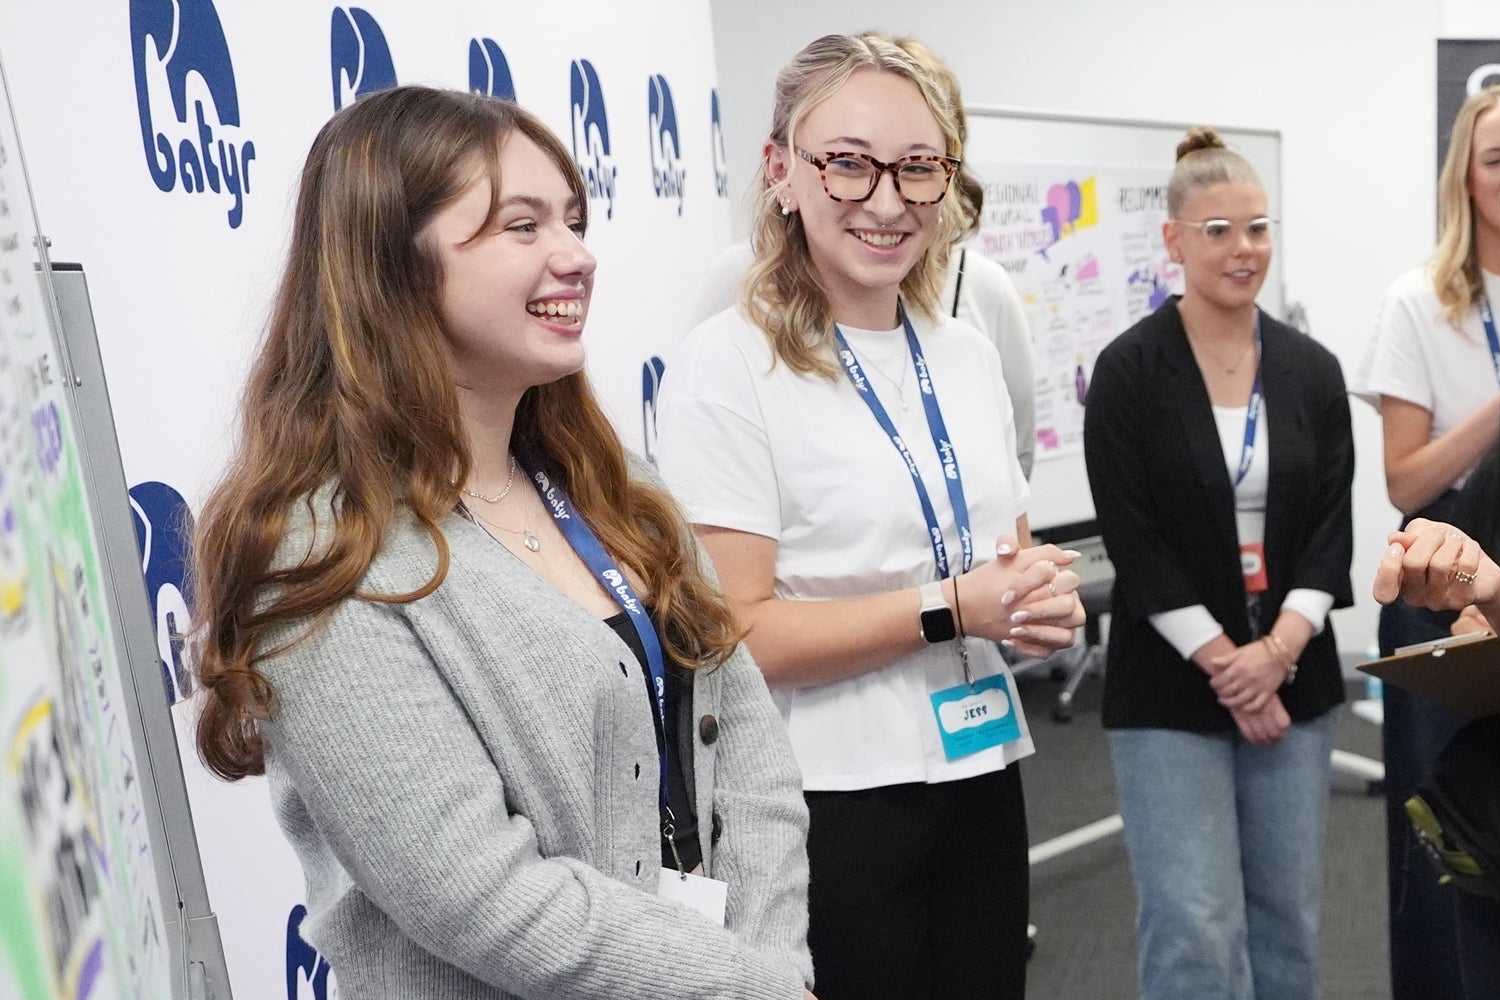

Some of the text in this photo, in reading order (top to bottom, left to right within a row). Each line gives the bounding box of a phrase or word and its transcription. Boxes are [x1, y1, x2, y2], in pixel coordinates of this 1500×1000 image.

[139, 99, 256, 229] batyr
[546, 486, 570, 521] batyr
[615, 585, 641, 616] batyr
